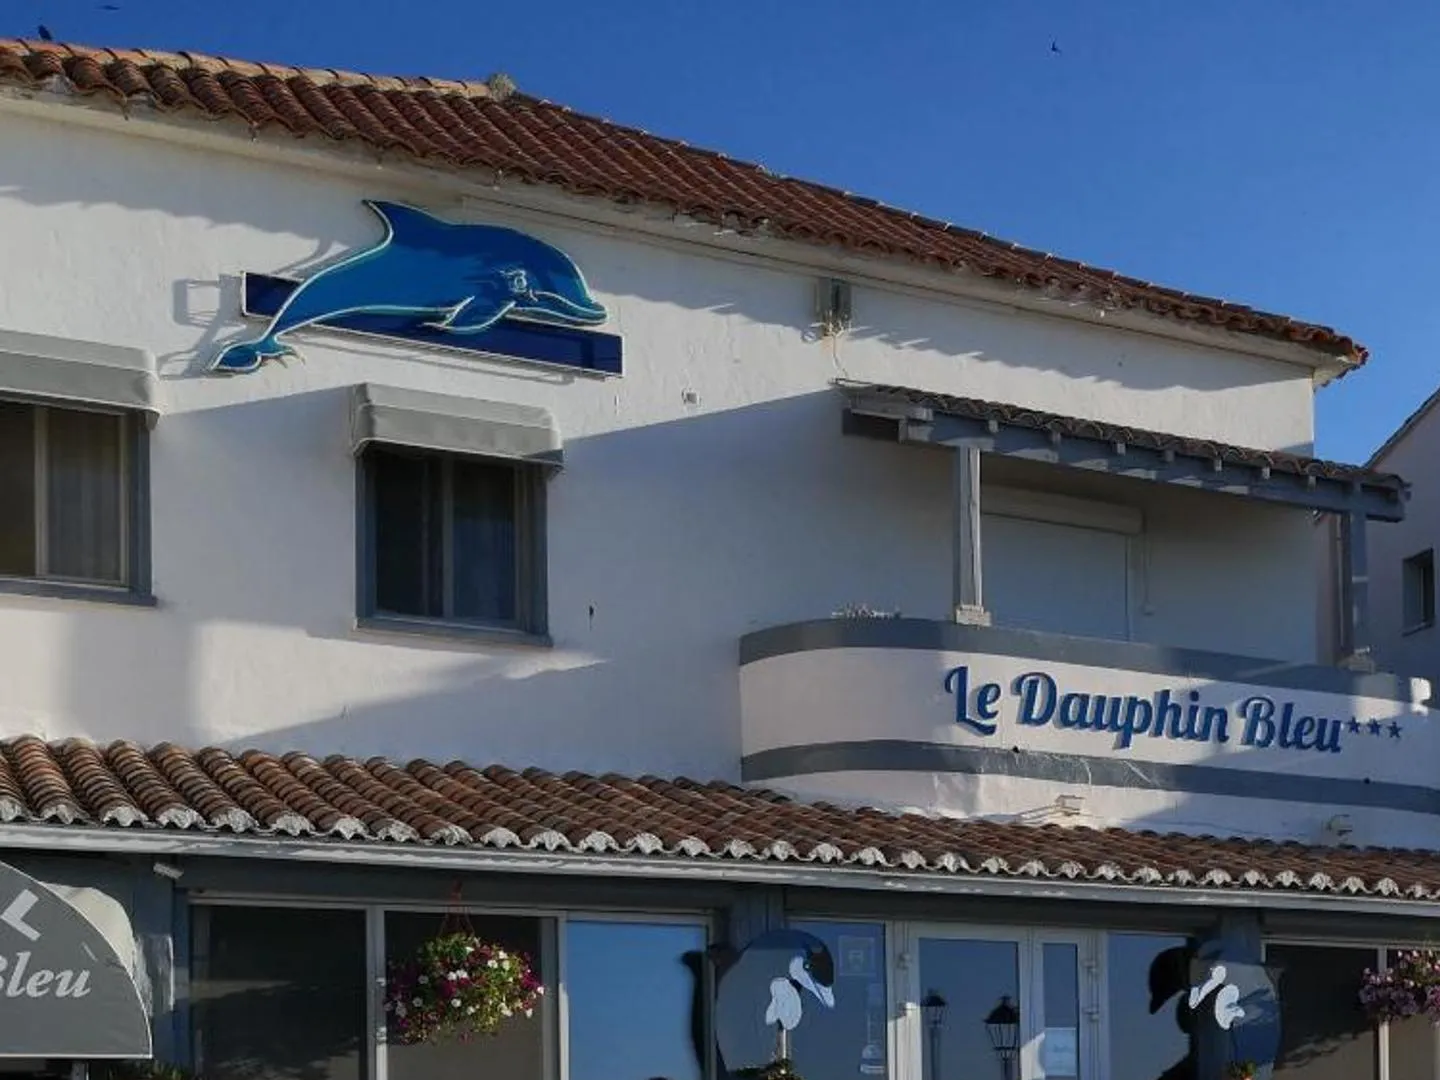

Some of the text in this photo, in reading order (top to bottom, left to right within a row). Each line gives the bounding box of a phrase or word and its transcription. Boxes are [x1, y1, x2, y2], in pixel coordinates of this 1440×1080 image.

[944, 665, 1343, 754] Le Dauphin Bleu
